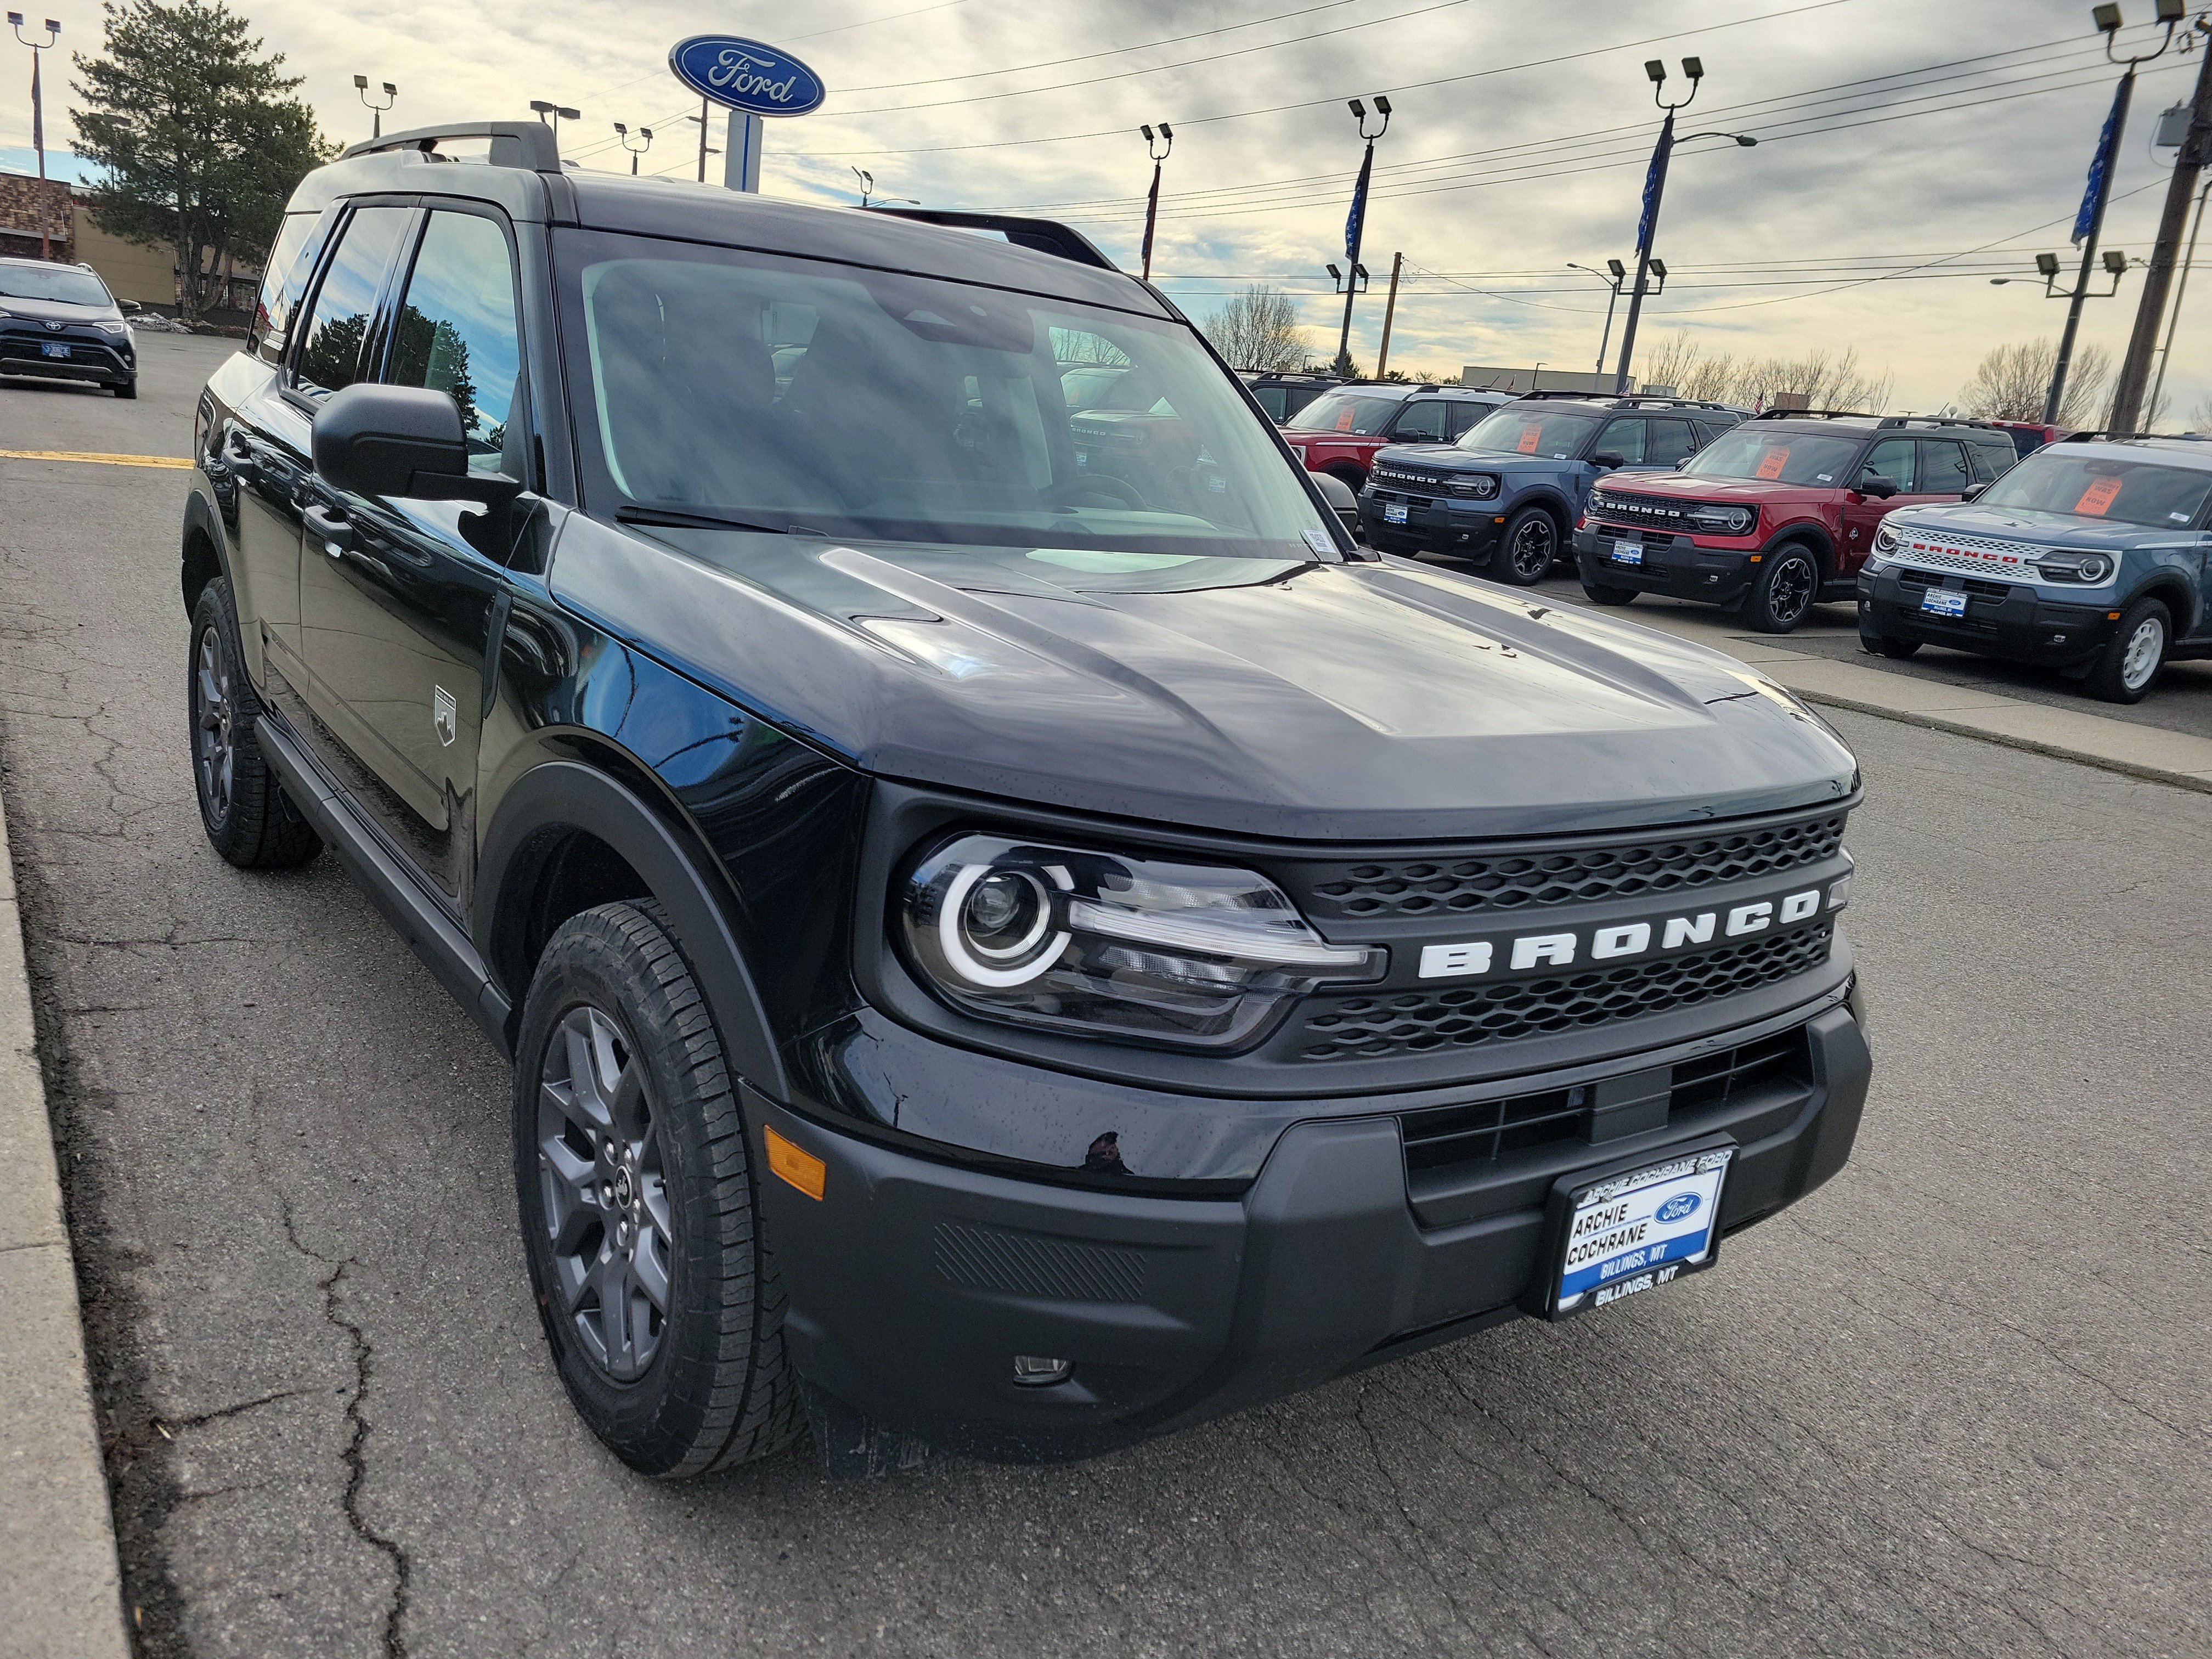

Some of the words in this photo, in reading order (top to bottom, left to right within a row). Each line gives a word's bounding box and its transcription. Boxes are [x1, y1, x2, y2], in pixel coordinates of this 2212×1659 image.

[708, 49, 797, 103] Ford
[1380, 470, 1437, 484] BRONCO
[2095, 486, 2113, 494] WAS
[1606, 503, 1680, 517] BRONCO
[2086, 496, 2106, 506] NOW
[1912, 543, 2019, 564] BRONCO
[1418, 889, 1820, 979] BRONCO
[1584, 1178, 1629, 1203] ARCHIE
[1630, 1159, 1697, 1184] COCHRANE
[1696, 1150, 1733, 1169] FORD
[1572, 1203, 1628, 1239] ARCHIE
[1662, 1197, 1693, 1221] Ford
[1567, 1222, 1649, 1266] COCHRANE
[1600, 1250, 1647, 1280] BILLINGS,
[1650, 1244, 1668, 1262] MT
[1595, 1274, 1654, 1307] BILLINGS,
[1657, 1265, 1679, 1285] MT
